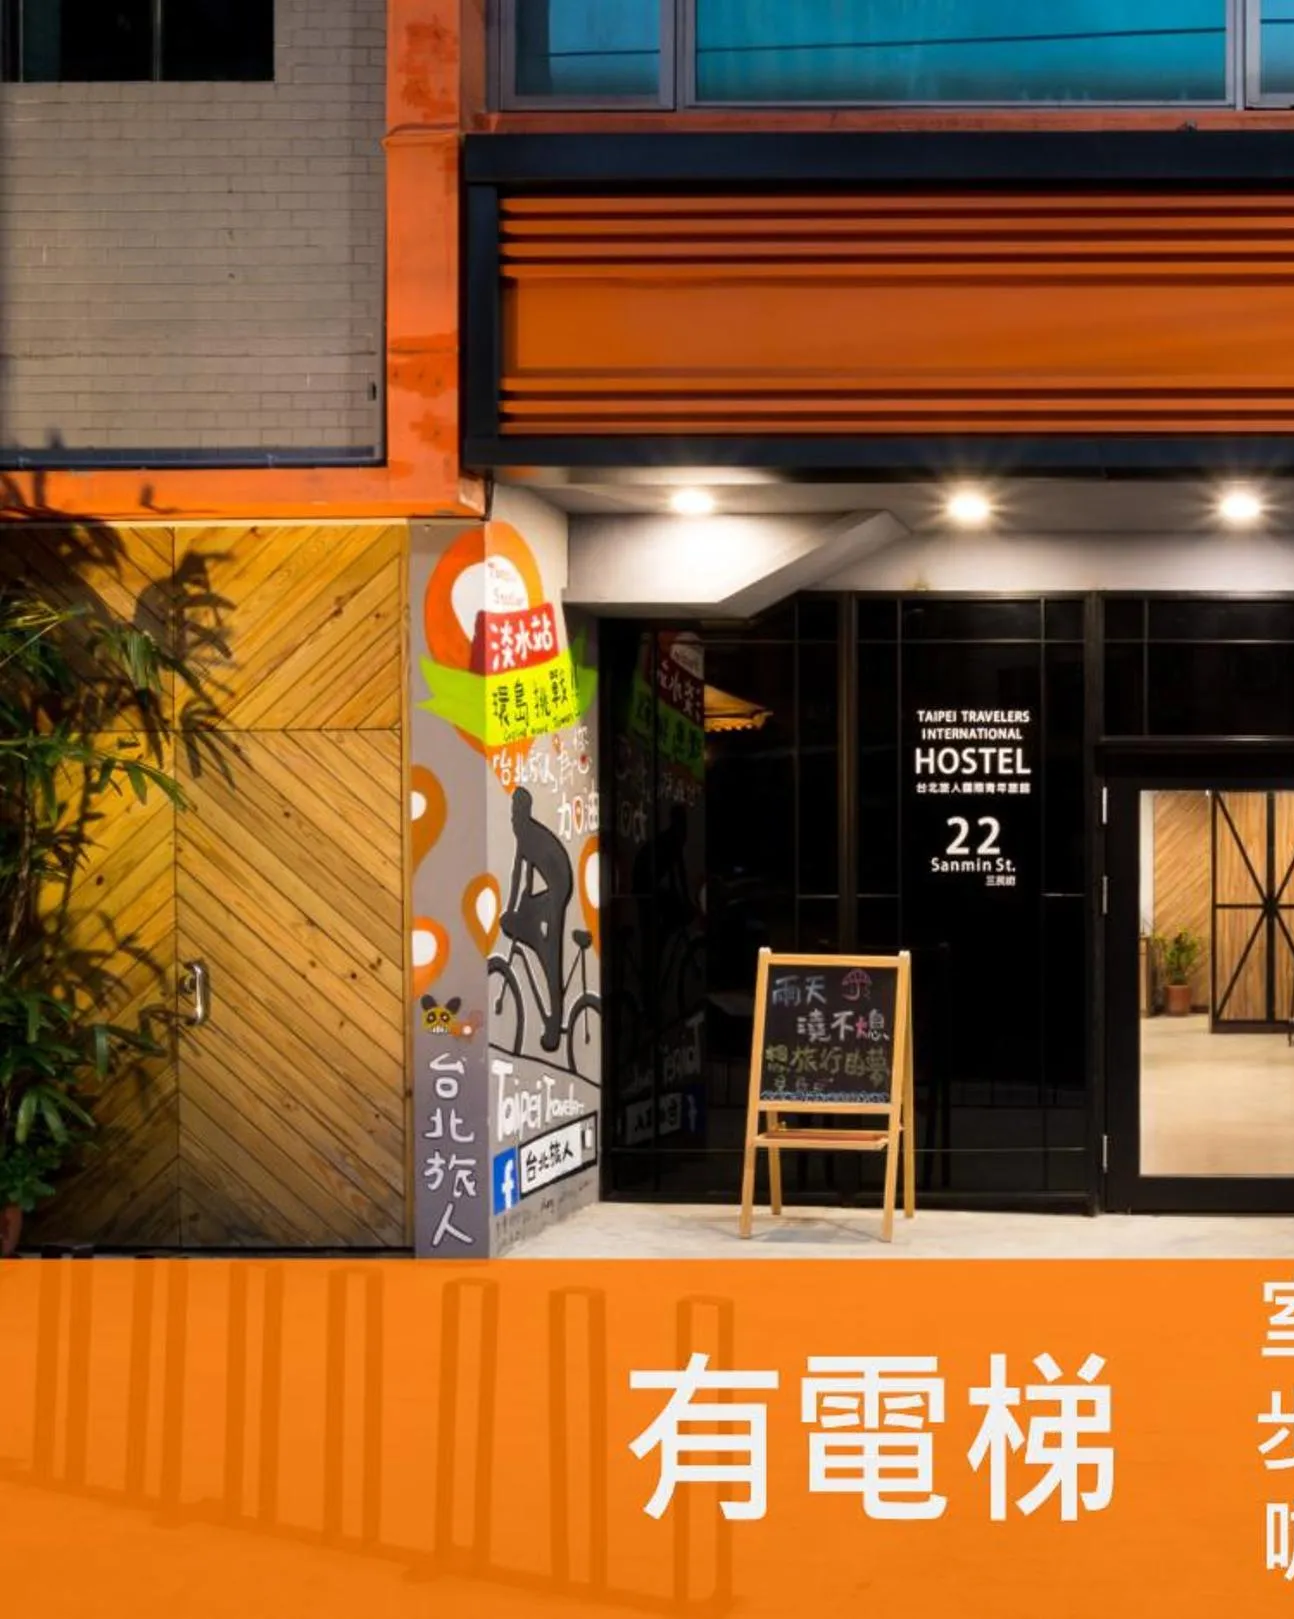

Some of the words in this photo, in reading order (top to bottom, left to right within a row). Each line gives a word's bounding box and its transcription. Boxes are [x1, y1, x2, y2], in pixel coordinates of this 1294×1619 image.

[489, 612, 553, 670] 淡水站
[917, 710, 957, 723] TAIPEI
[960, 710, 1030, 723] TRAVELERS
[921, 727, 1023, 740] INTERNATIONAL
[915, 747, 1032, 775] HOSTEL
[946, 816, 1001, 855] 22
[931, 857, 992, 872] Sanmin
[995, 857, 1016, 872] St.
[772, 975, 827, 1006] 雨天
[796, 1008, 890, 1042] 澆不熄
[491, 1059, 541, 1142] Taipei
[424, 1052, 477, 1246] 台北旅人
[526, 1141, 573, 1183] 台北旅人
